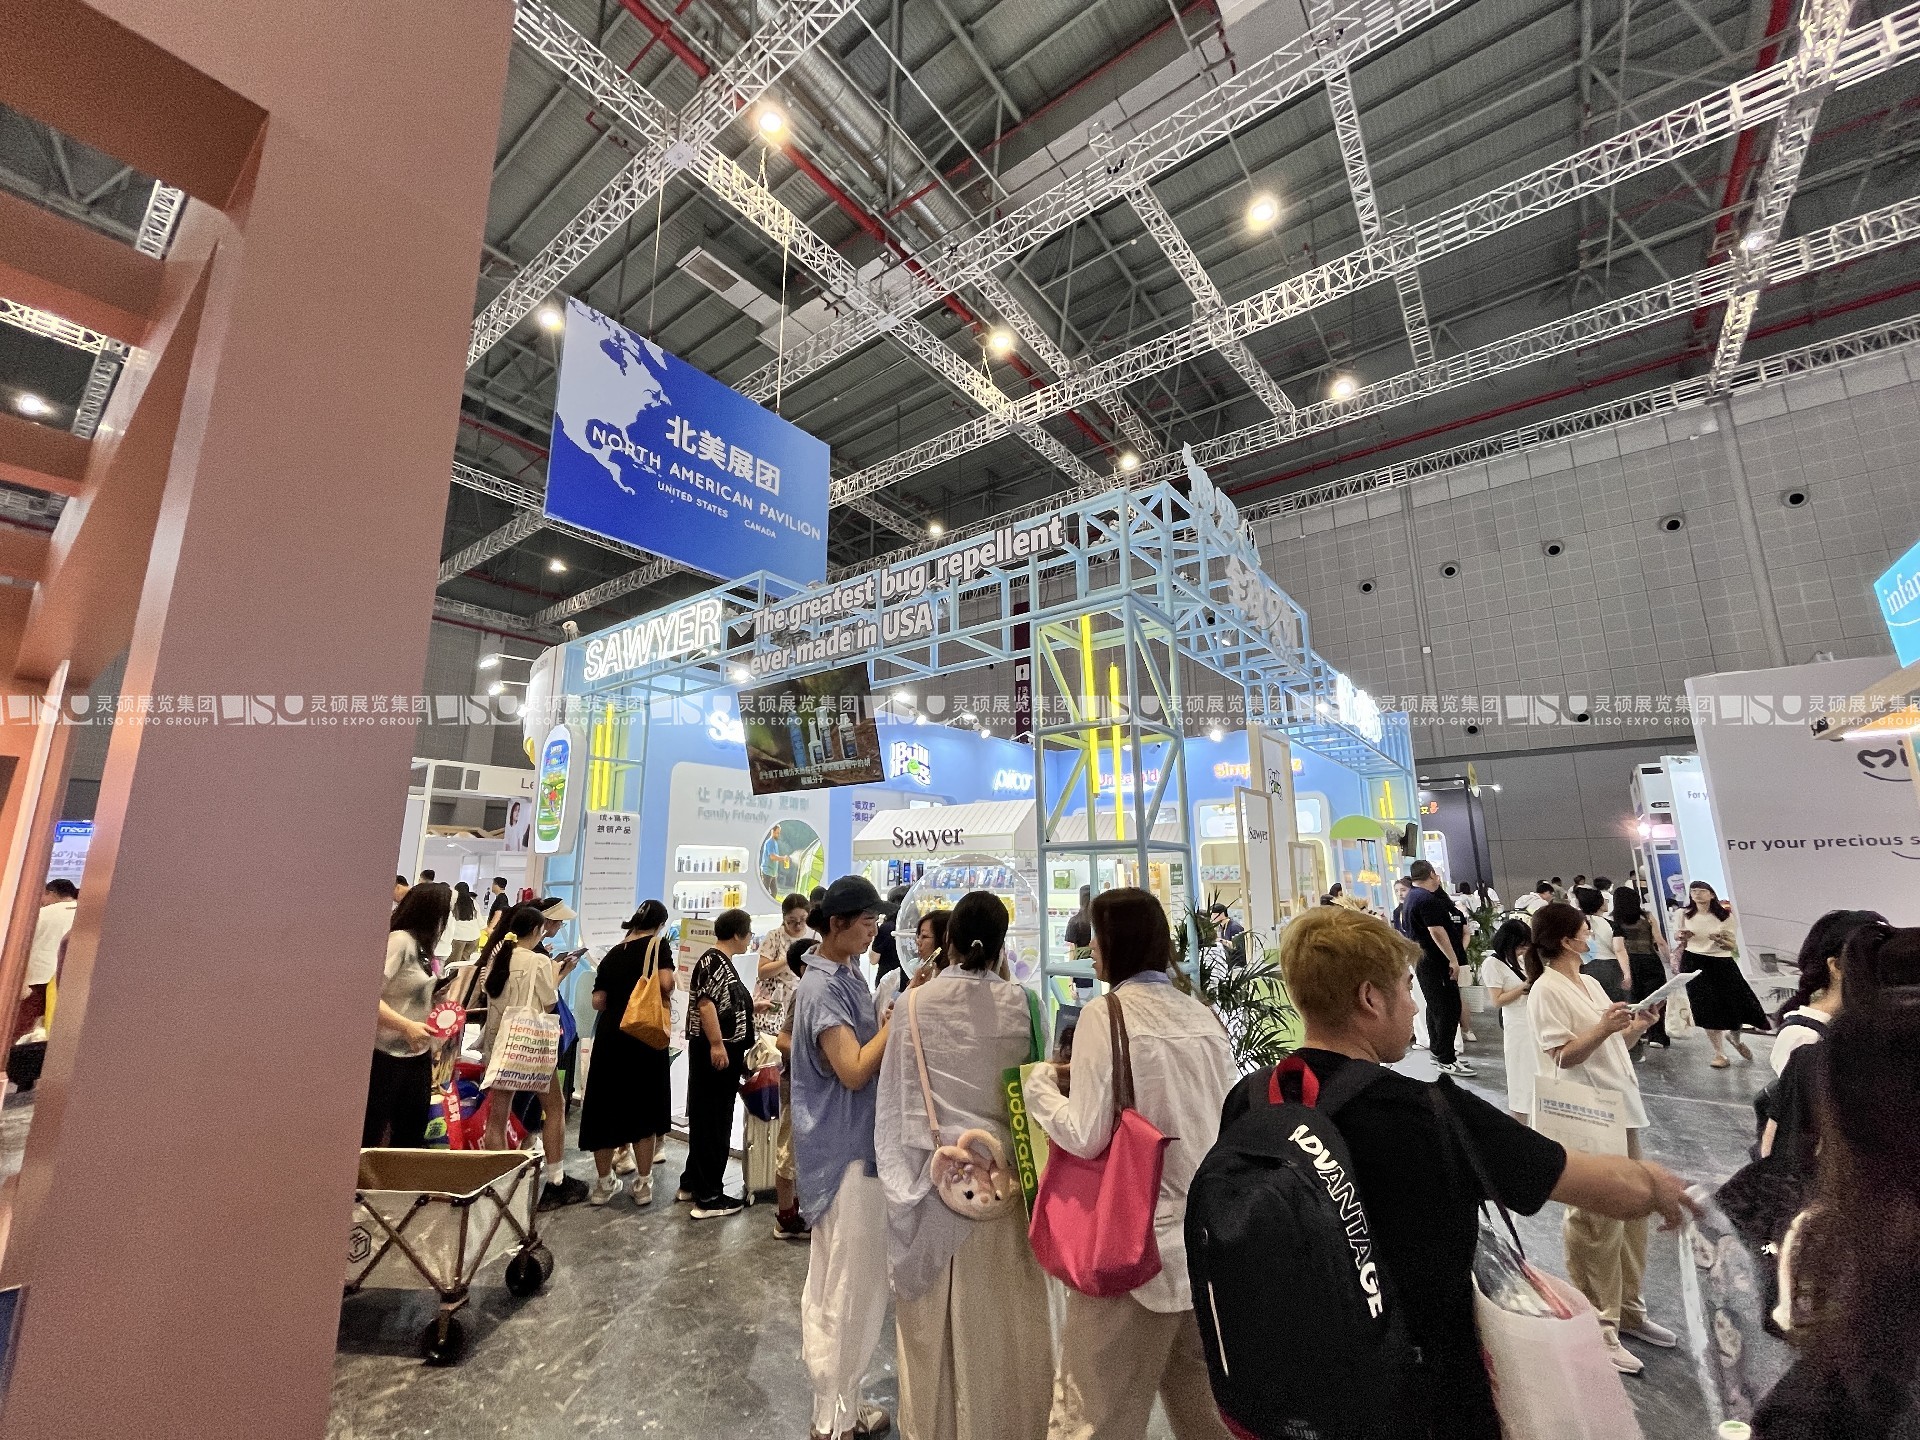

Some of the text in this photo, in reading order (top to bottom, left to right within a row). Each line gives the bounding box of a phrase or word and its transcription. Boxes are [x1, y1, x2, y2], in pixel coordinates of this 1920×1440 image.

[666, 414, 780, 496] 北美展团
[593, 425, 821, 540] NORTH AMERICAN PAVILION
[657, 481, 728, 518] UNITED STATES
[744, 520, 777, 538] CANADA
[752, 516, 1065, 636] The greatest bug repellent
[584, 597, 724, 683] SAWYER
[750, 603, 934, 675] ever made in USA
[892, 826, 964, 851] Sawyer
[1248, 826, 1268, 843] Sawyer
[1727, 839, 1756, 850] For
[1762, 838, 1807, 851] your
[1813, 834, 1903, 850] precious
[497, 1068, 552, 1081] HermanMiller
[1288, 1124, 1384, 1319] ADVANTAGE
